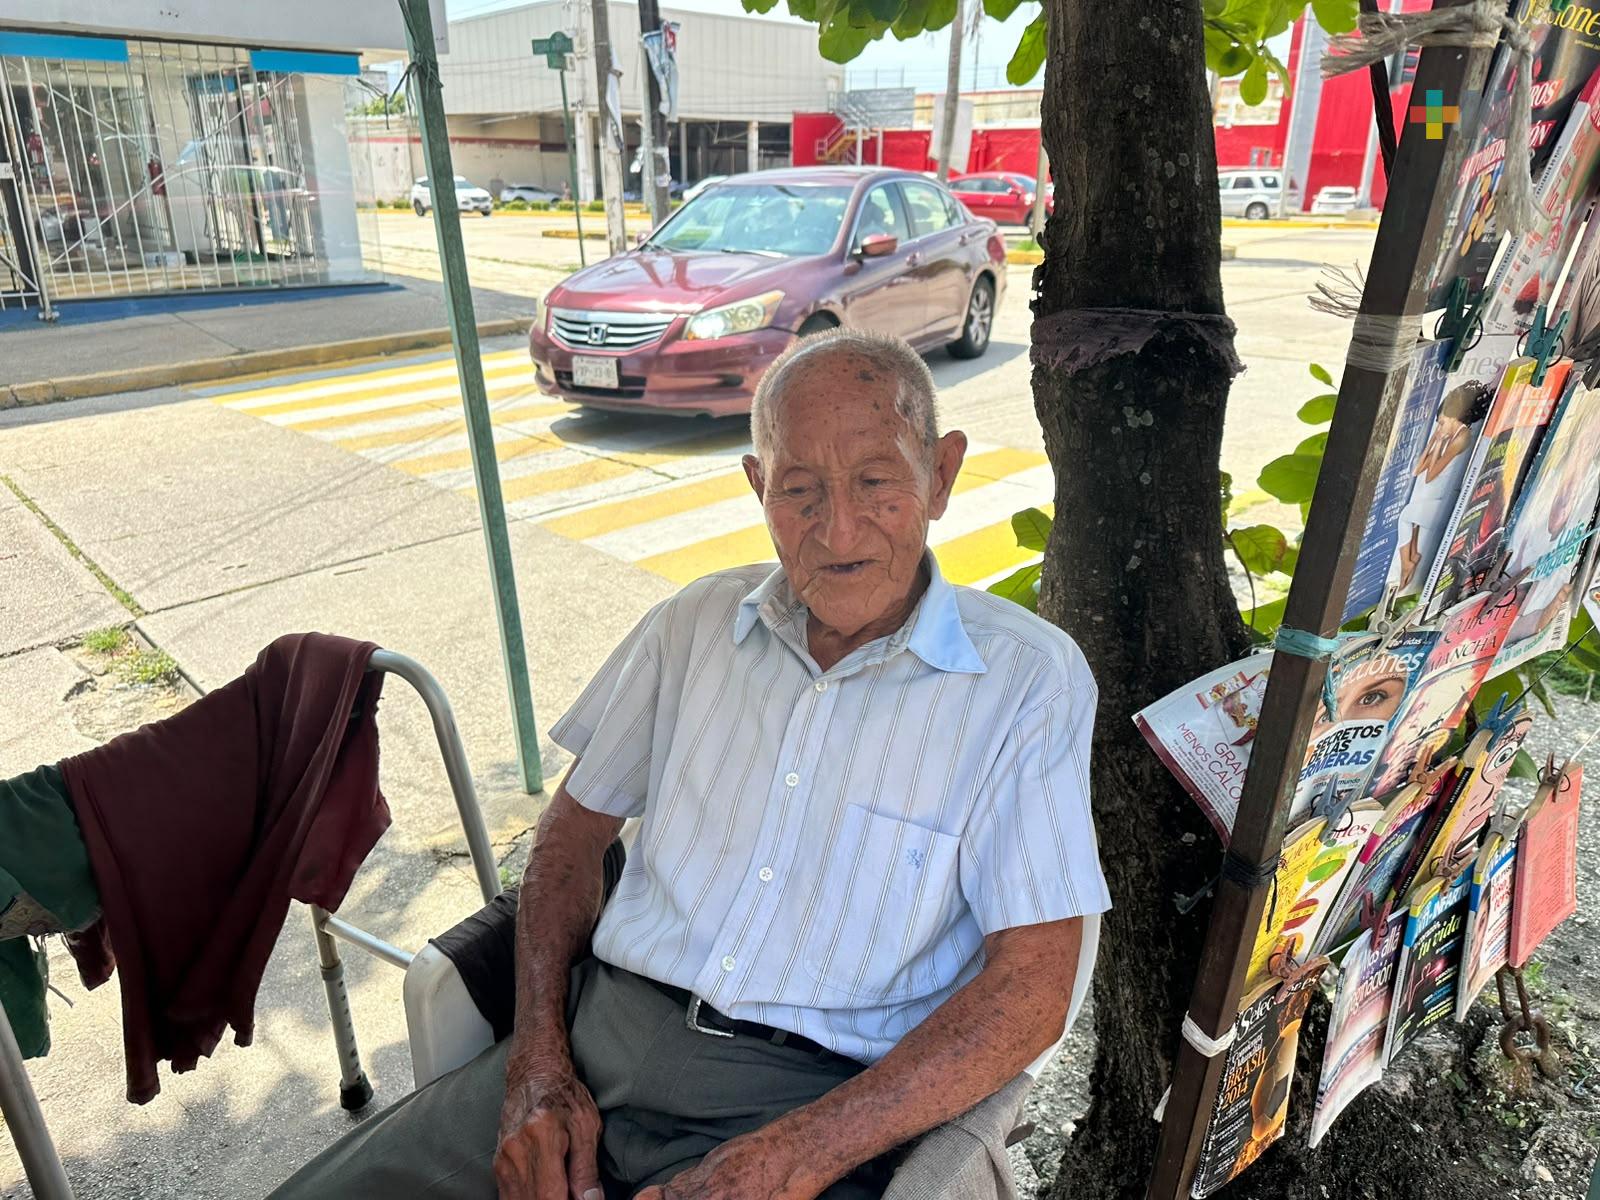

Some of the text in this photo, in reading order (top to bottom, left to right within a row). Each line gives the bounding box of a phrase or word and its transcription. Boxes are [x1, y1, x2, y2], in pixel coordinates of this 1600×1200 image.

[1316, 724, 1384, 752] SECRETOS
[1176, 722, 1212, 763] MENOS
[1208, 760, 1244, 802] CALO
[1299, 749, 1376, 783] ERMERAS
[1432, 914, 1462, 947] vida
[1226, 1046, 1266, 1091] BRASIL
[1221, 1077, 1249, 1110] 2014
